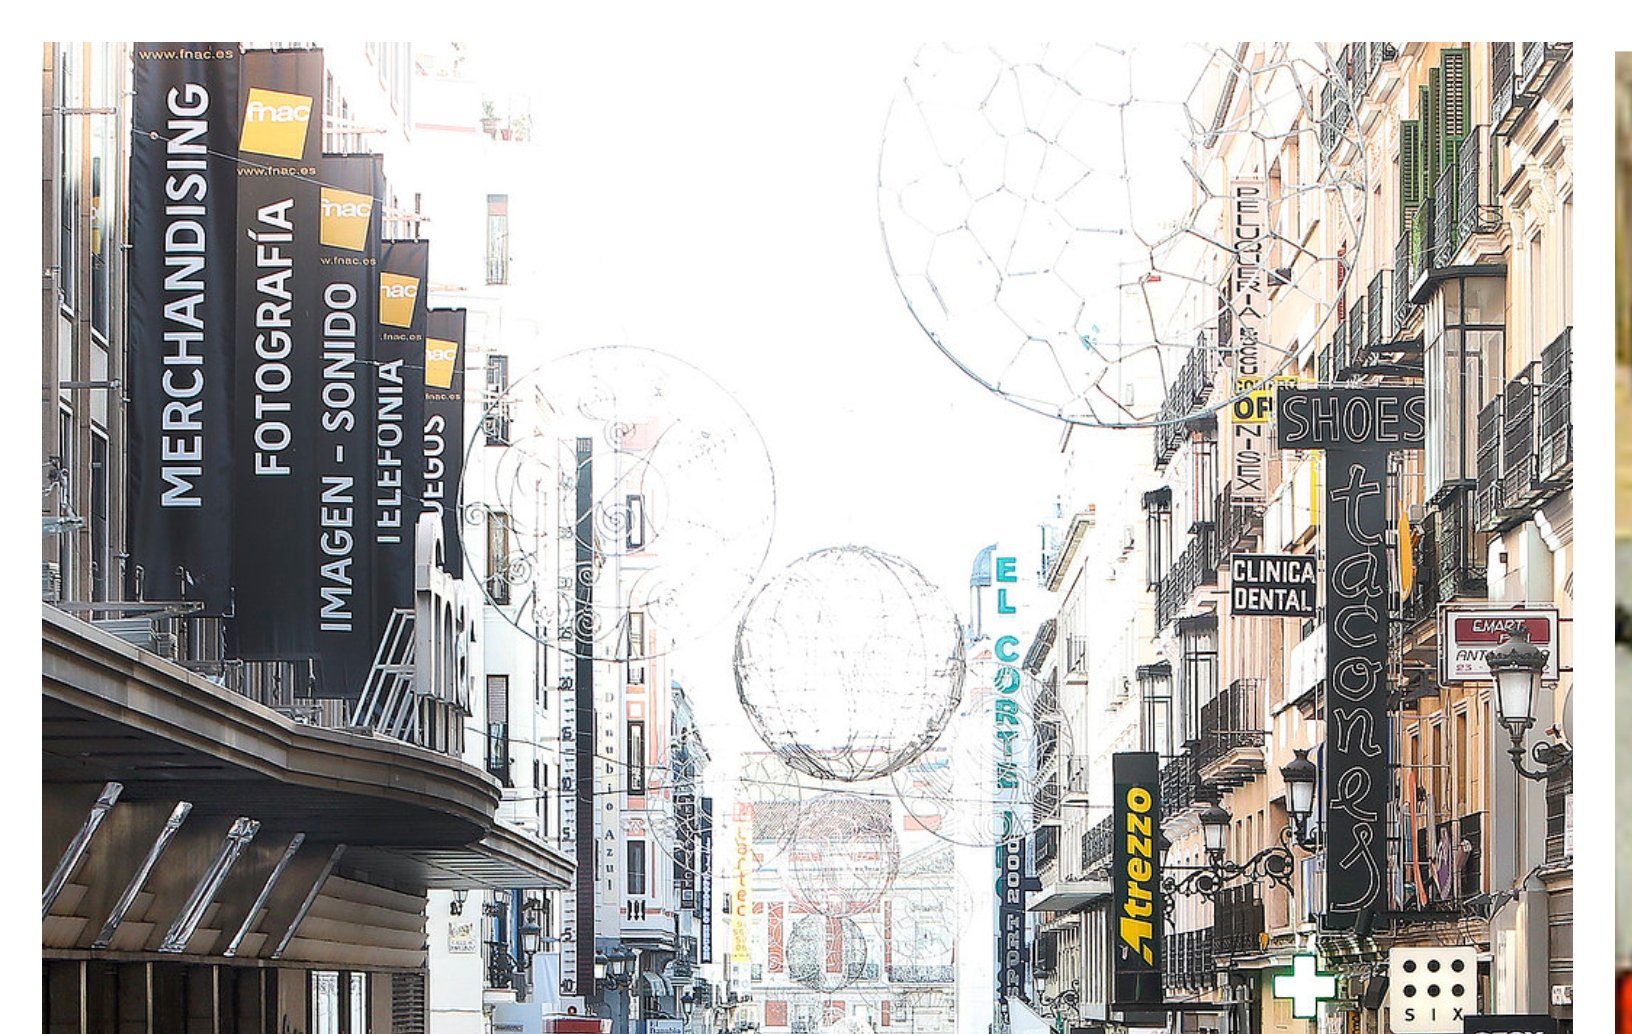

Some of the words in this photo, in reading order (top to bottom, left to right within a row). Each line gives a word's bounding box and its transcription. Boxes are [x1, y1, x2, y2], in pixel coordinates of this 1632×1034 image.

[138, 48, 234, 60] www.fnac.es
[246, 100, 310, 123] fnac
[320, 255, 376, 267] w.fnac.es
[380, 282, 417, 298] nac
[160, 82, 210, 508] MERCHANDISING
[248, 198, 296, 477] FOTOGRAFÍA
[322, 282, 358, 432] SONIDO
[1283, 395, 1426, 443] SHOES
[424, 414, 445, 518] UEGOS
[1236, 424, 1262, 491] NISEX
[320, 476, 354, 633] IMAGEN
[996, 556, 1018, 615] EL
[1234, 557, 1315, 584] CLINICA
[1234, 586, 1312, 613] DENTAL
[993, 635, 1021, 789] CORTE
[1330, 463, 1383, 913] tacones
[605, 829, 615, 891] Azul
[1006, 839, 1021, 904] 2000
[1119, 786, 1153, 968] Atrezzo
[1403, 1007, 1464, 1022] SIX
